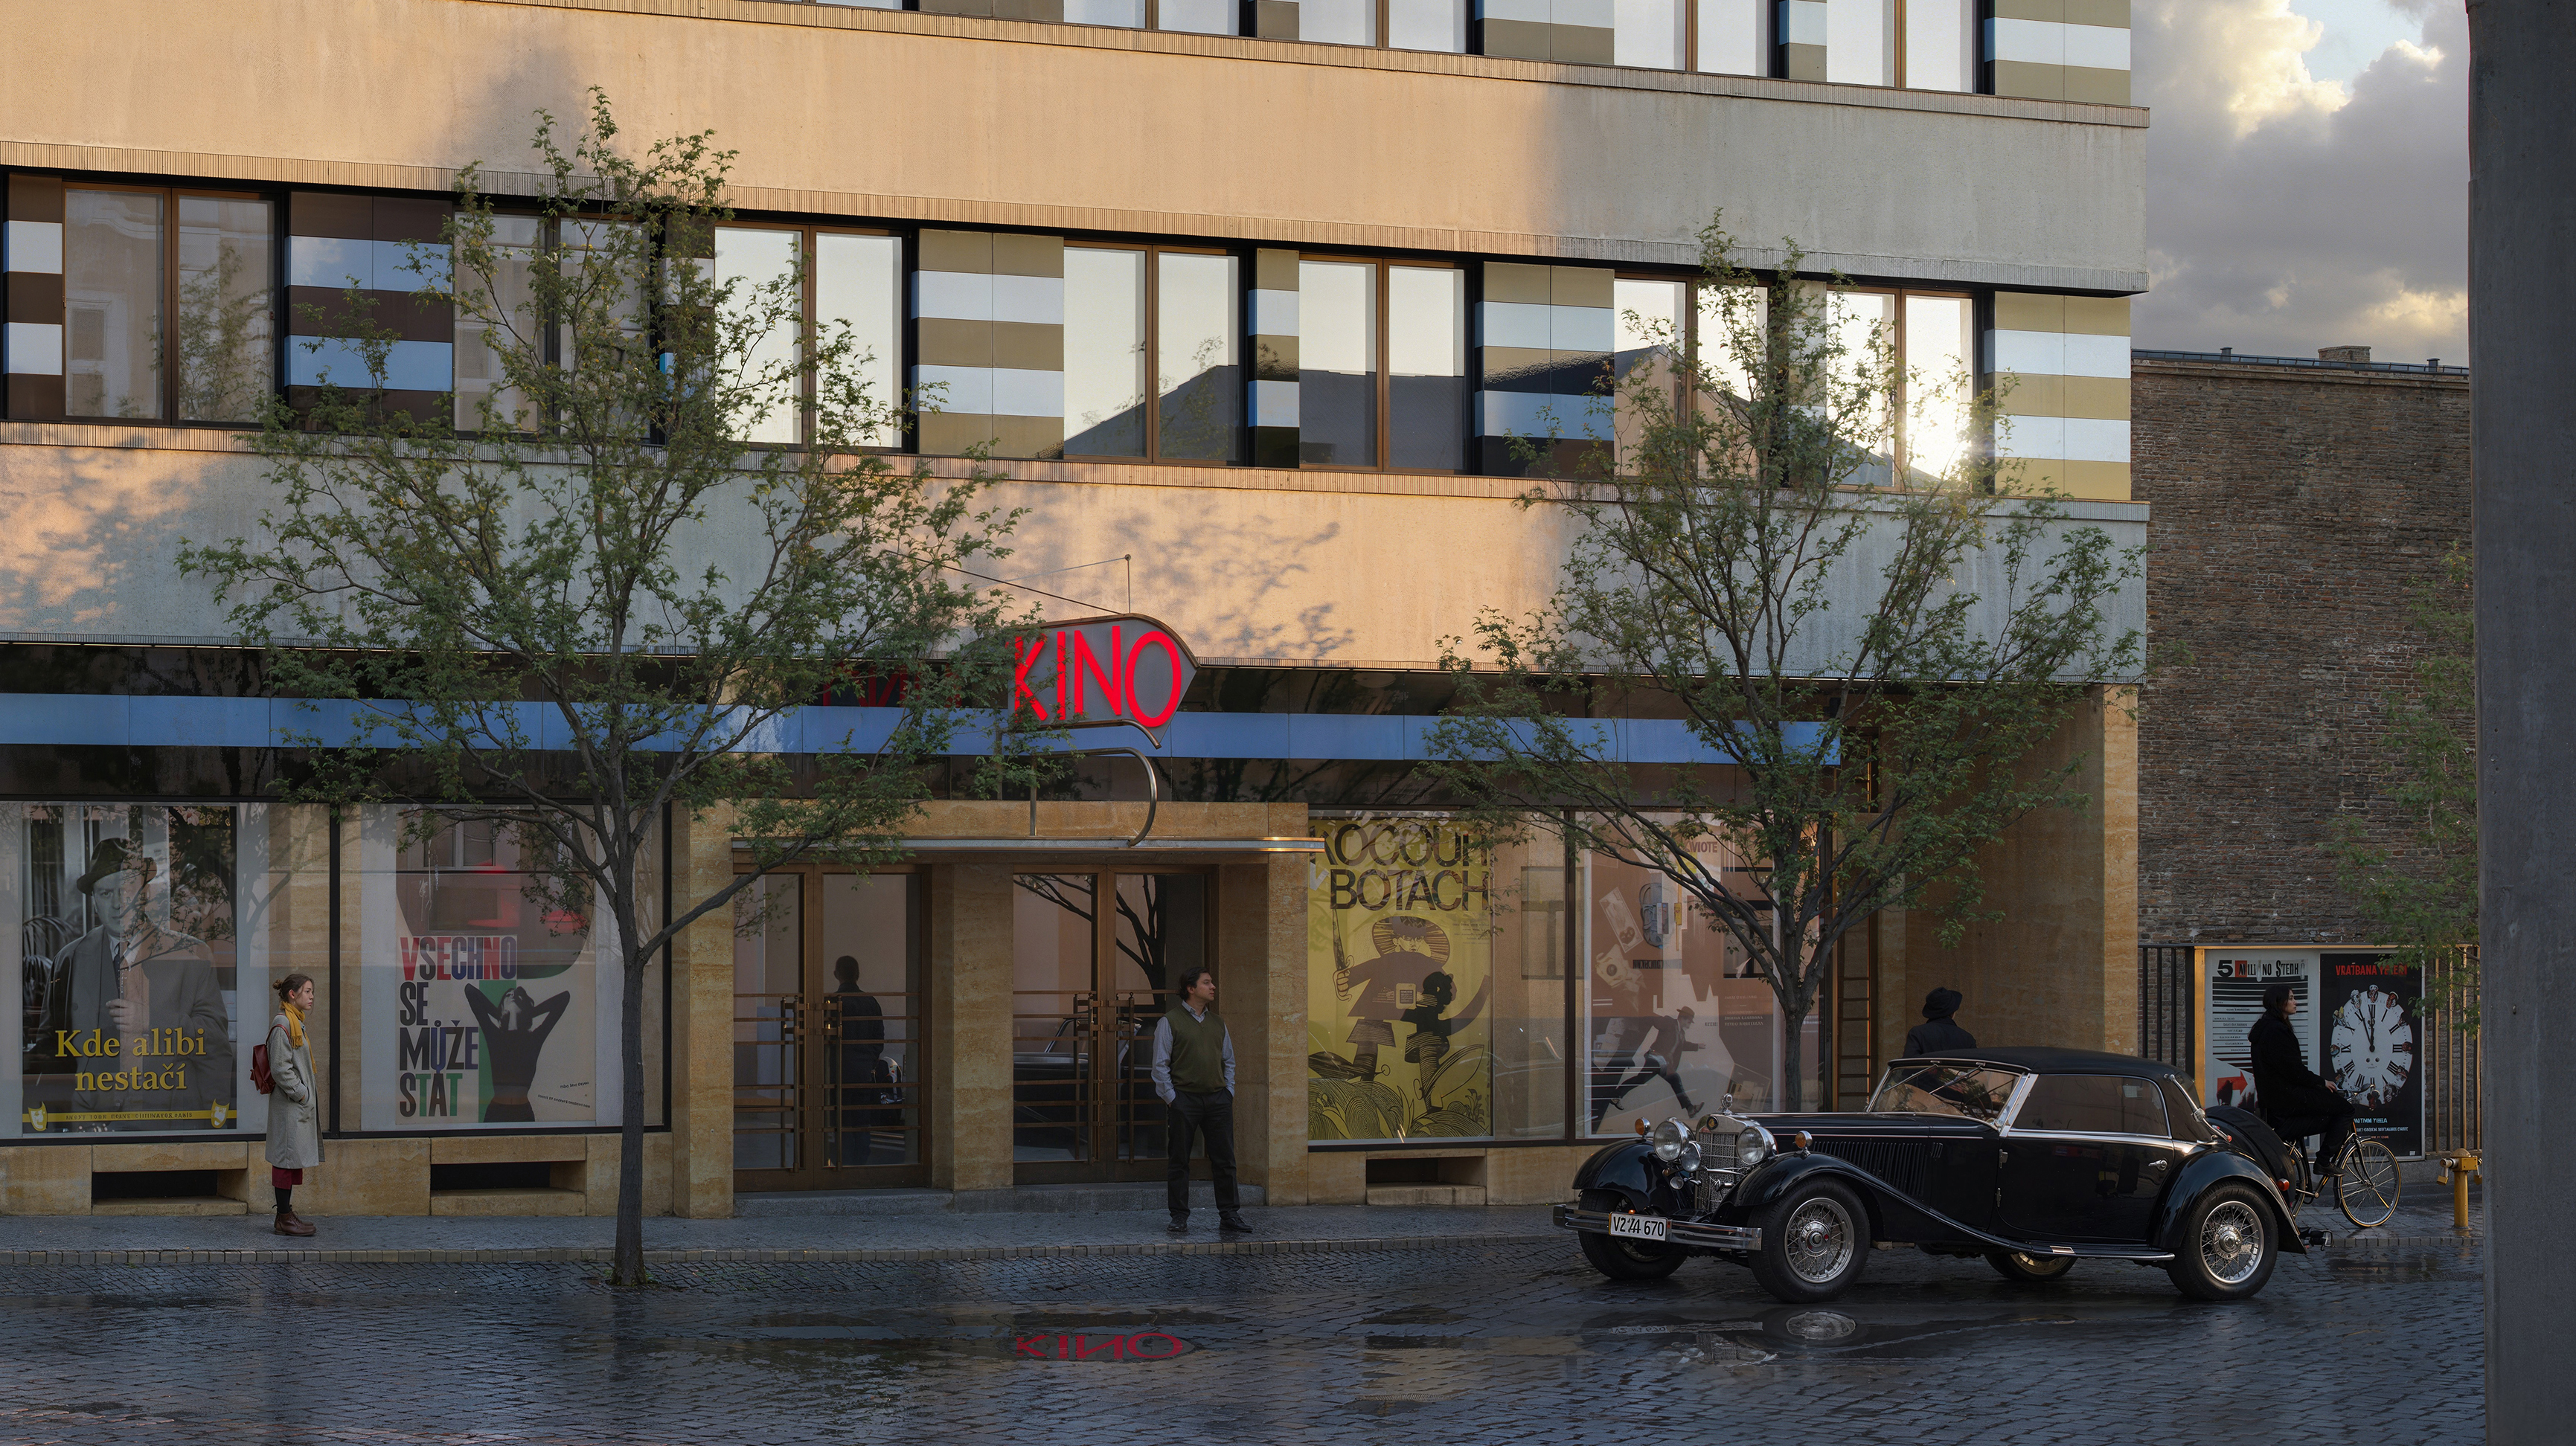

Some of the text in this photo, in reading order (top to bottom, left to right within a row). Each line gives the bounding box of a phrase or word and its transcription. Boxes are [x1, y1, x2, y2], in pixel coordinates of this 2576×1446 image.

[1013, 626, 1182, 727] KINO
[400, 936, 517, 980] VSECHNO
[2217, 960, 2233, 977] 5
[400, 981, 429, 1026] SE
[55, 1027, 207, 1057] Kde alibi
[400, 1020, 478, 1070] MŮŽE
[75, 1062, 187, 1091] nestačí
[1644, 1221, 1665, 1237] 670
